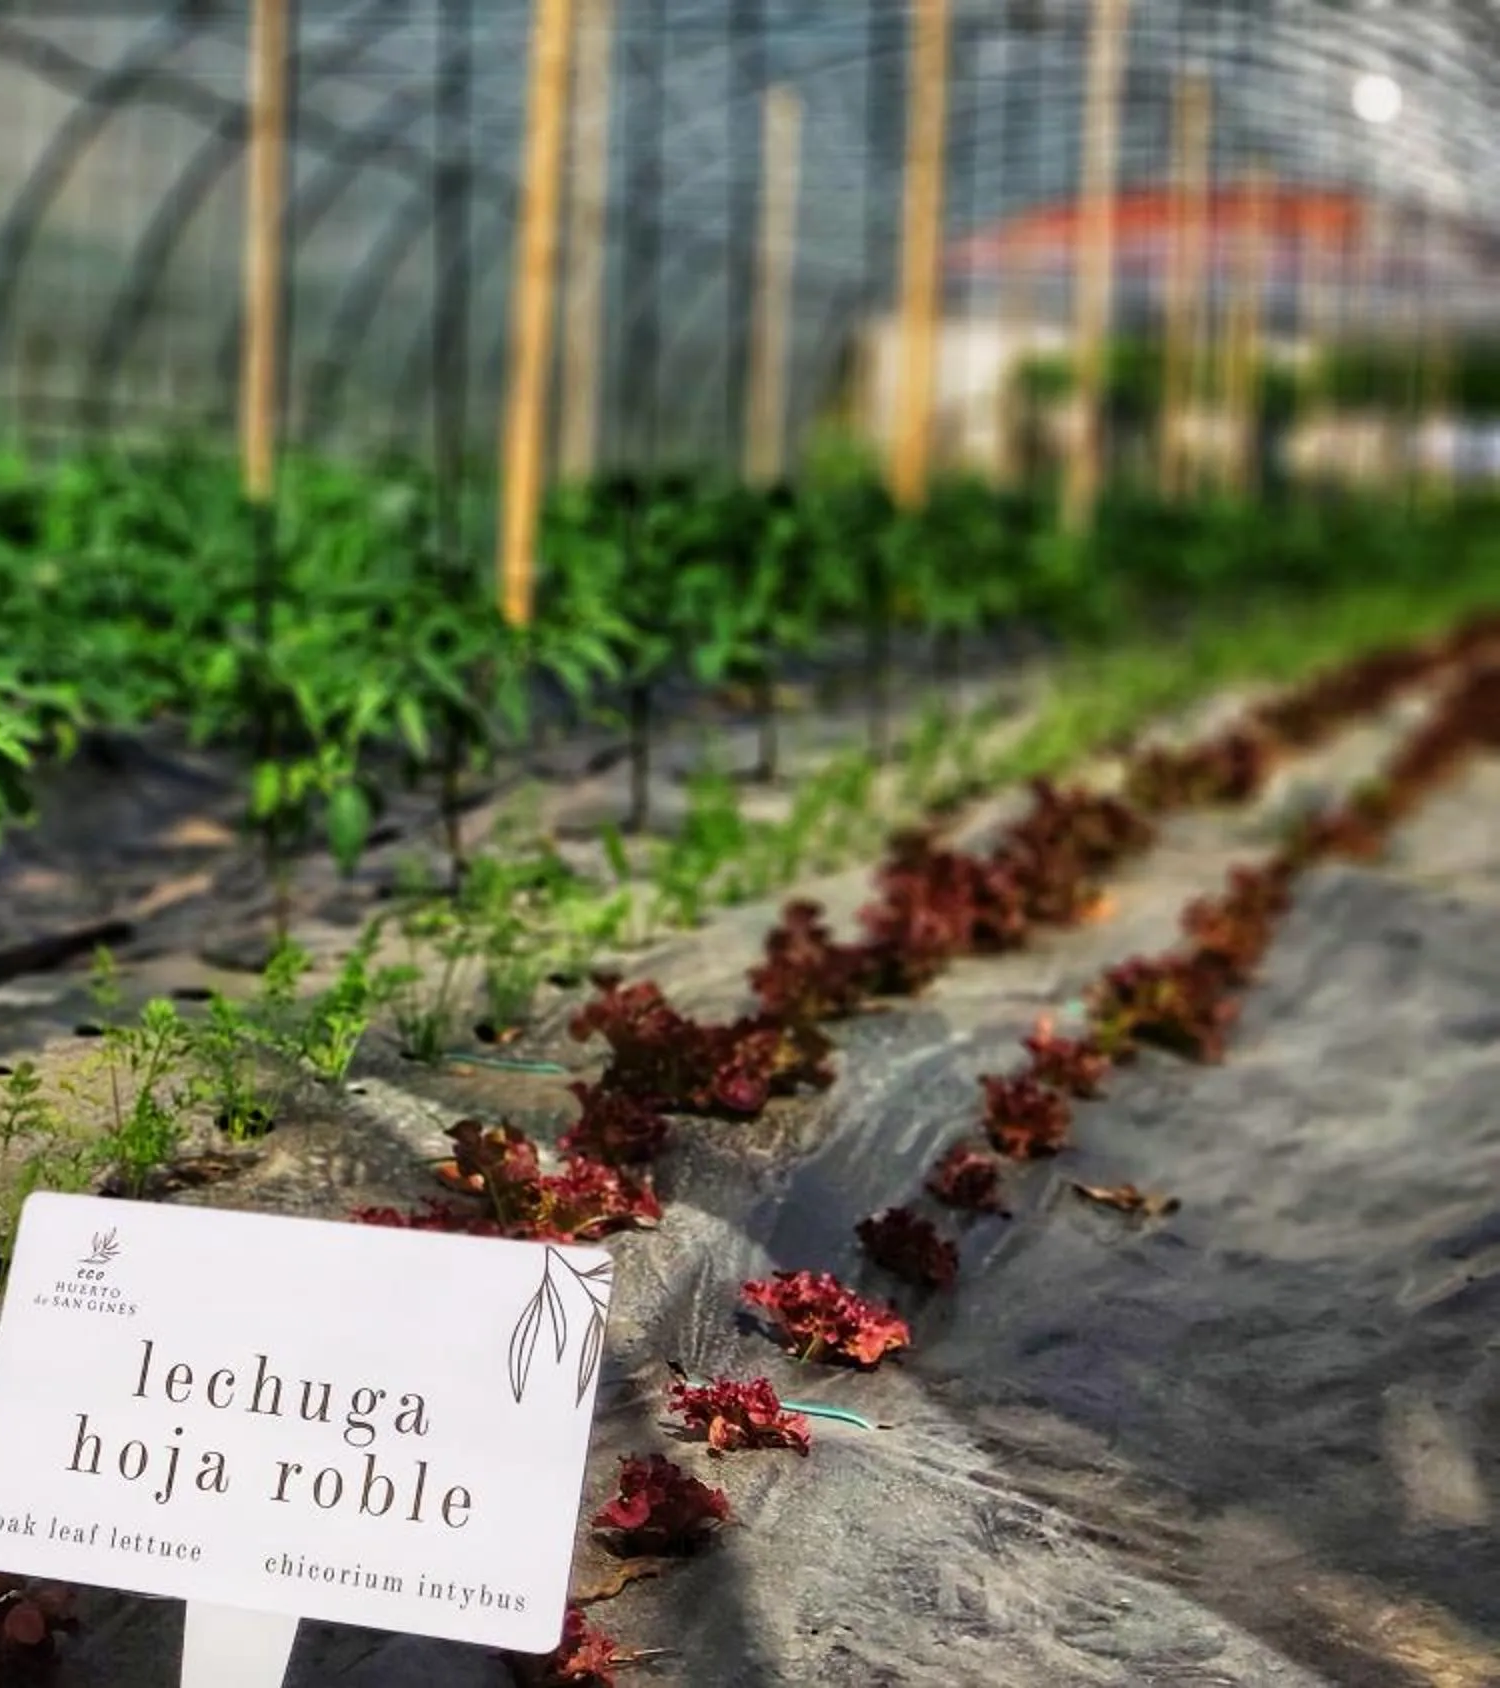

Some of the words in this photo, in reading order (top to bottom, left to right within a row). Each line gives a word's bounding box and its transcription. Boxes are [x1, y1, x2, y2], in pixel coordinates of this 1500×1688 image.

[54, 1280, 122, 1299] HUERTO
[76, 1267, 105, 1281] eco
[51, 1295, 83, 1310] SAN
[132, 1339, 432, 1448] lechuga
[64, 1413, 231, 1505] hoja
[268, 1454, 474, 1530] roble
[48, 1516, 101, 1546] leaf
[110, 1527, 203, 1563] lettuce
[264, 1552, 403, 1594] chicorium
[418, 1572, 528, 1613] intybus
